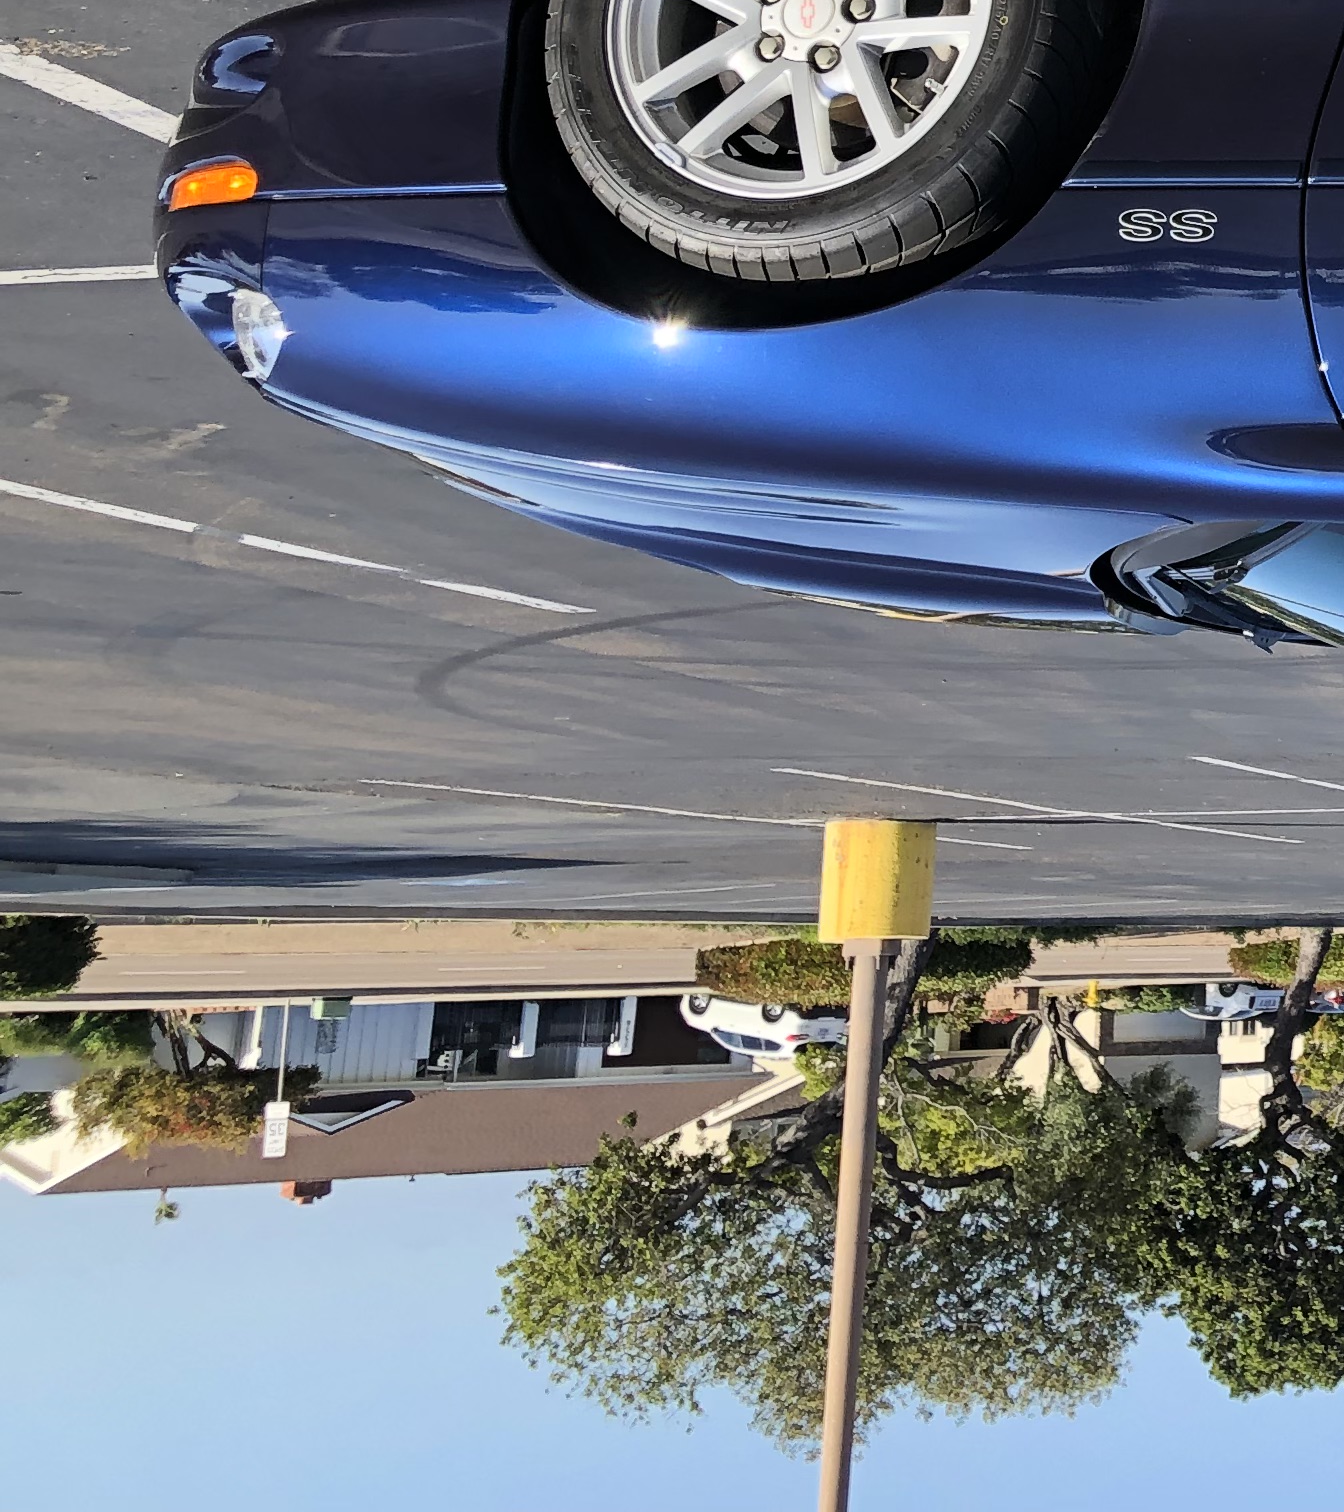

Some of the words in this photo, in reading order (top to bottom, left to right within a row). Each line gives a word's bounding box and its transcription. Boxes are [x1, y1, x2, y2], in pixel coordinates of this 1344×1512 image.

[654, 196, 788, 234] NITTO
[1118, 208, 1218, 243] SS
[268, 1123, 285, 1136] 35
